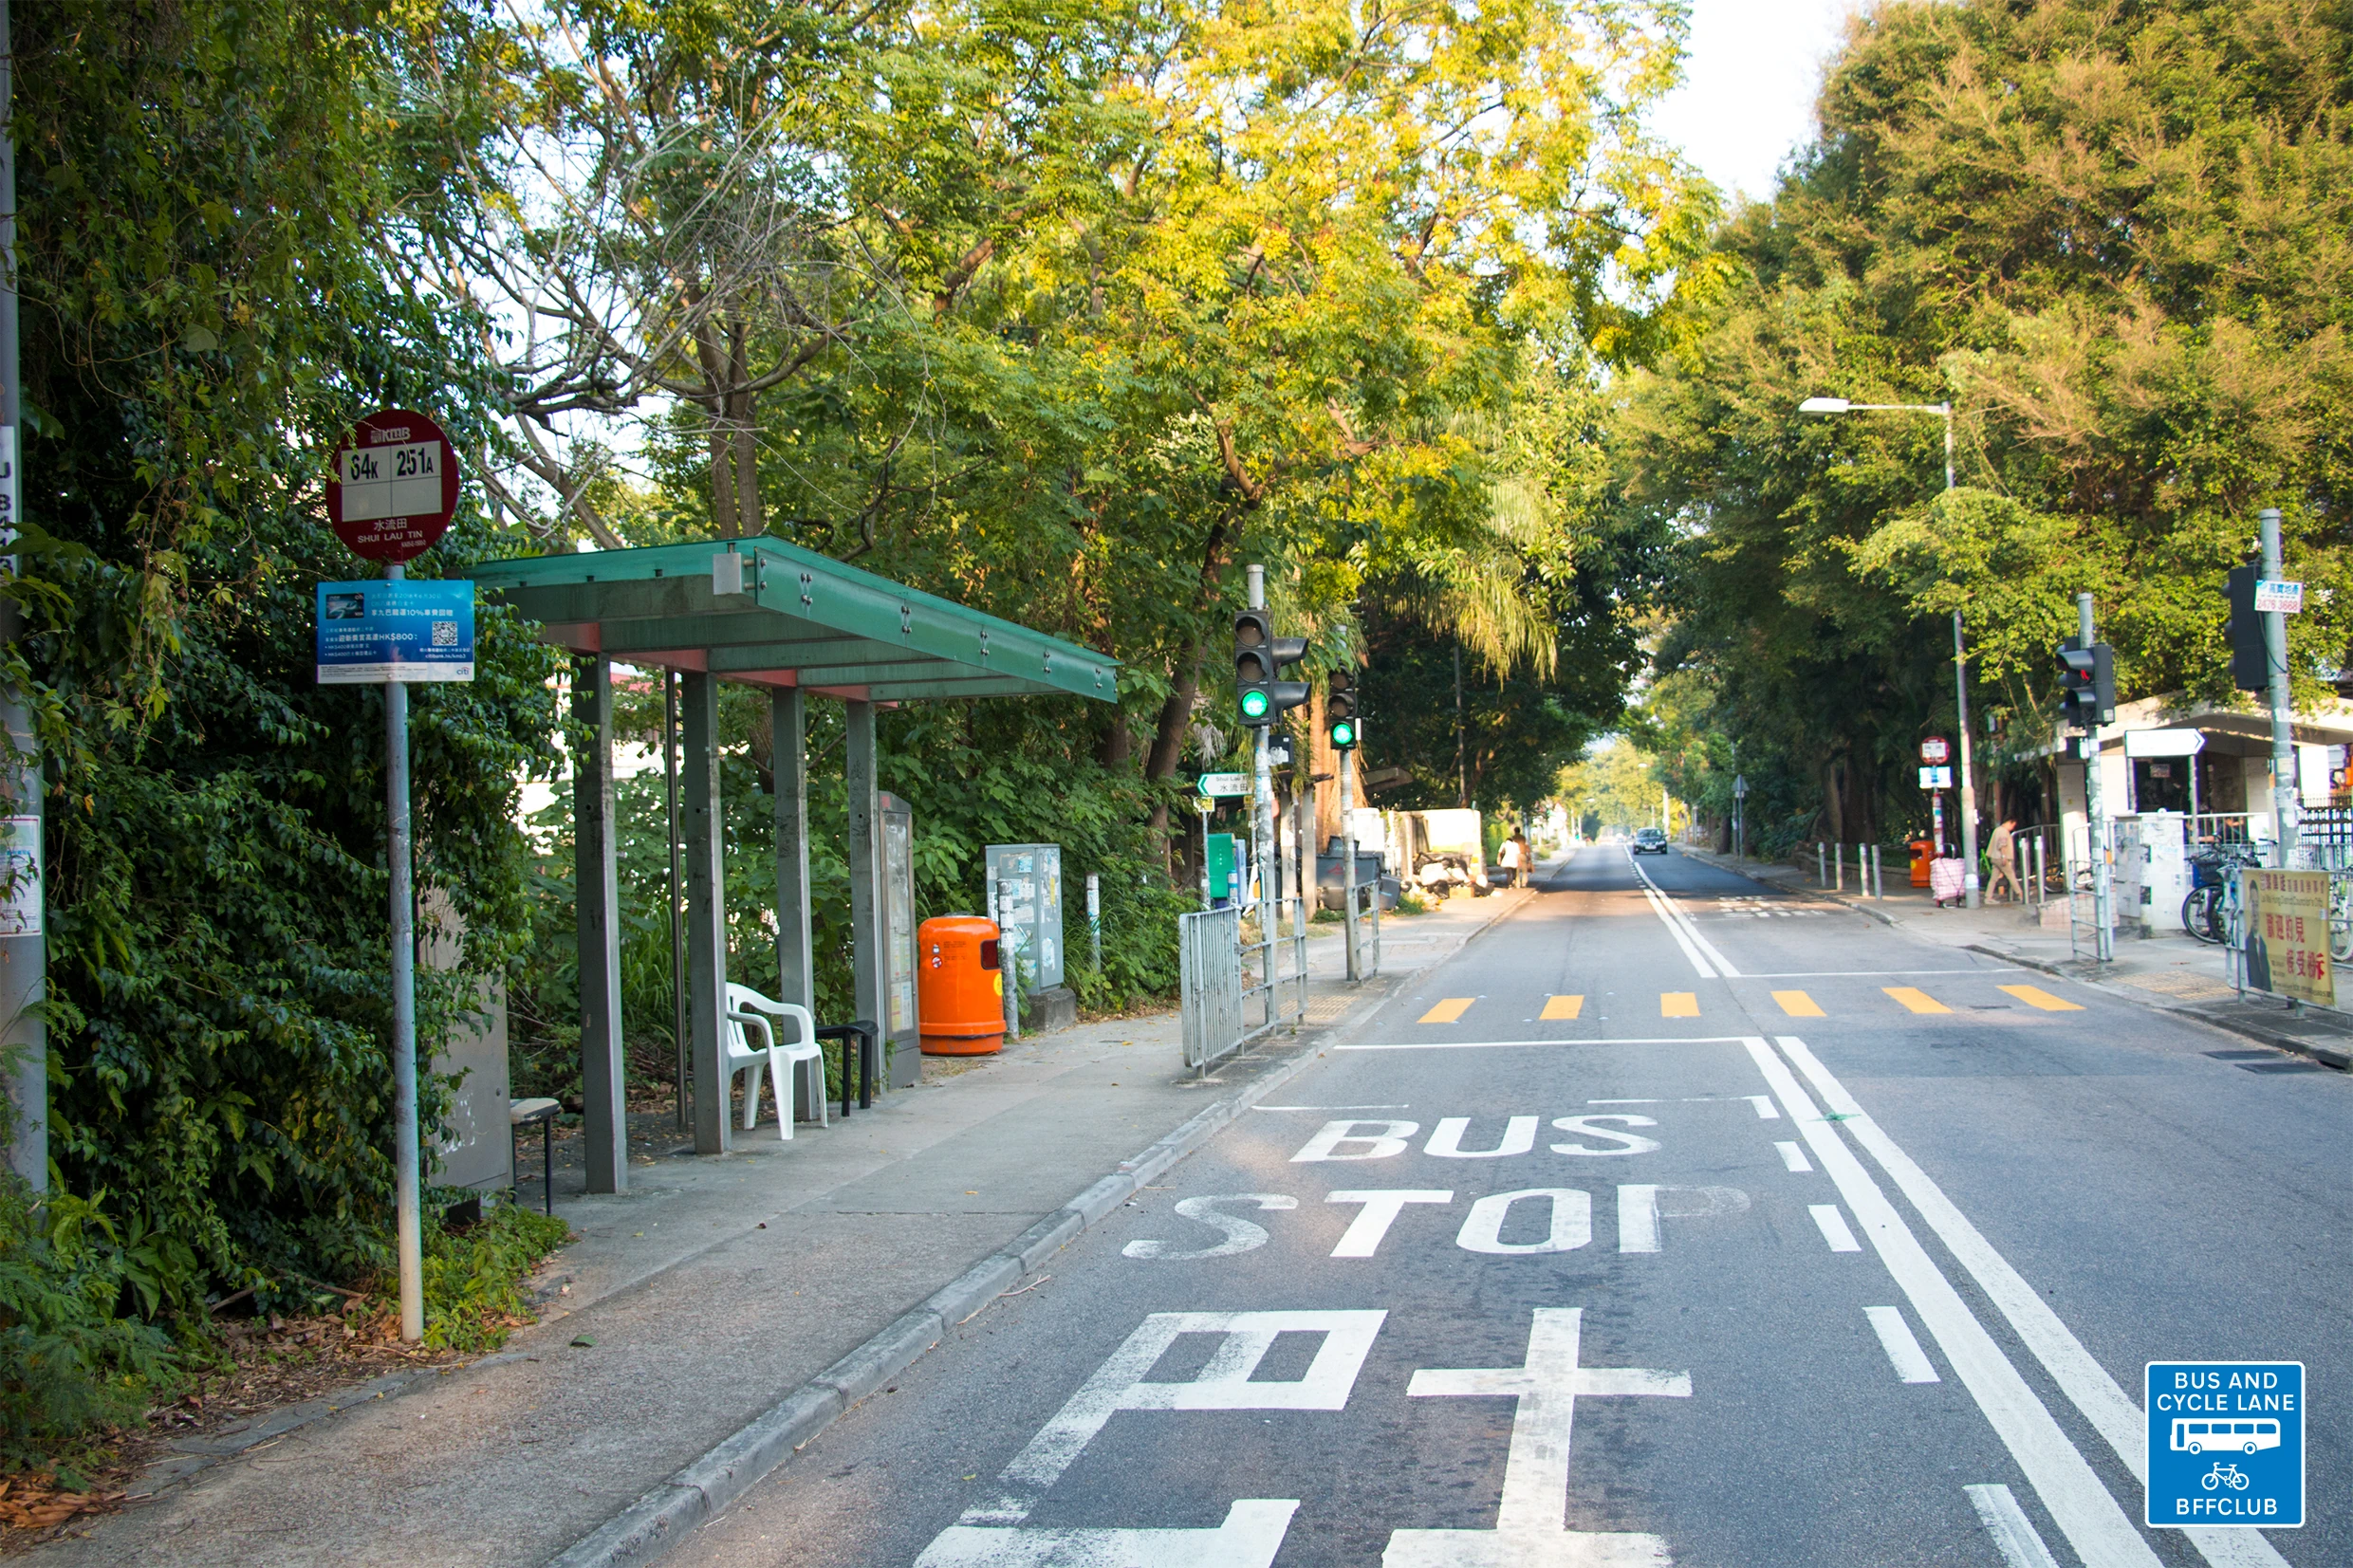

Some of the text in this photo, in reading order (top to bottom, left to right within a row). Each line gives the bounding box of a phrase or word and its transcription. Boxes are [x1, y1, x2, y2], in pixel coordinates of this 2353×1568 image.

[350, 447, 434, 481] 64K 251A
[374, 518, 408, 531] 水流田
[358, 530, 423, 544] SHUI LAU TIN
[1219, 783, 1248, 793] 水流田
[1289, 1114, 1661, 1163] BUS
[1121, 1183, 1751, 1259] STOP
